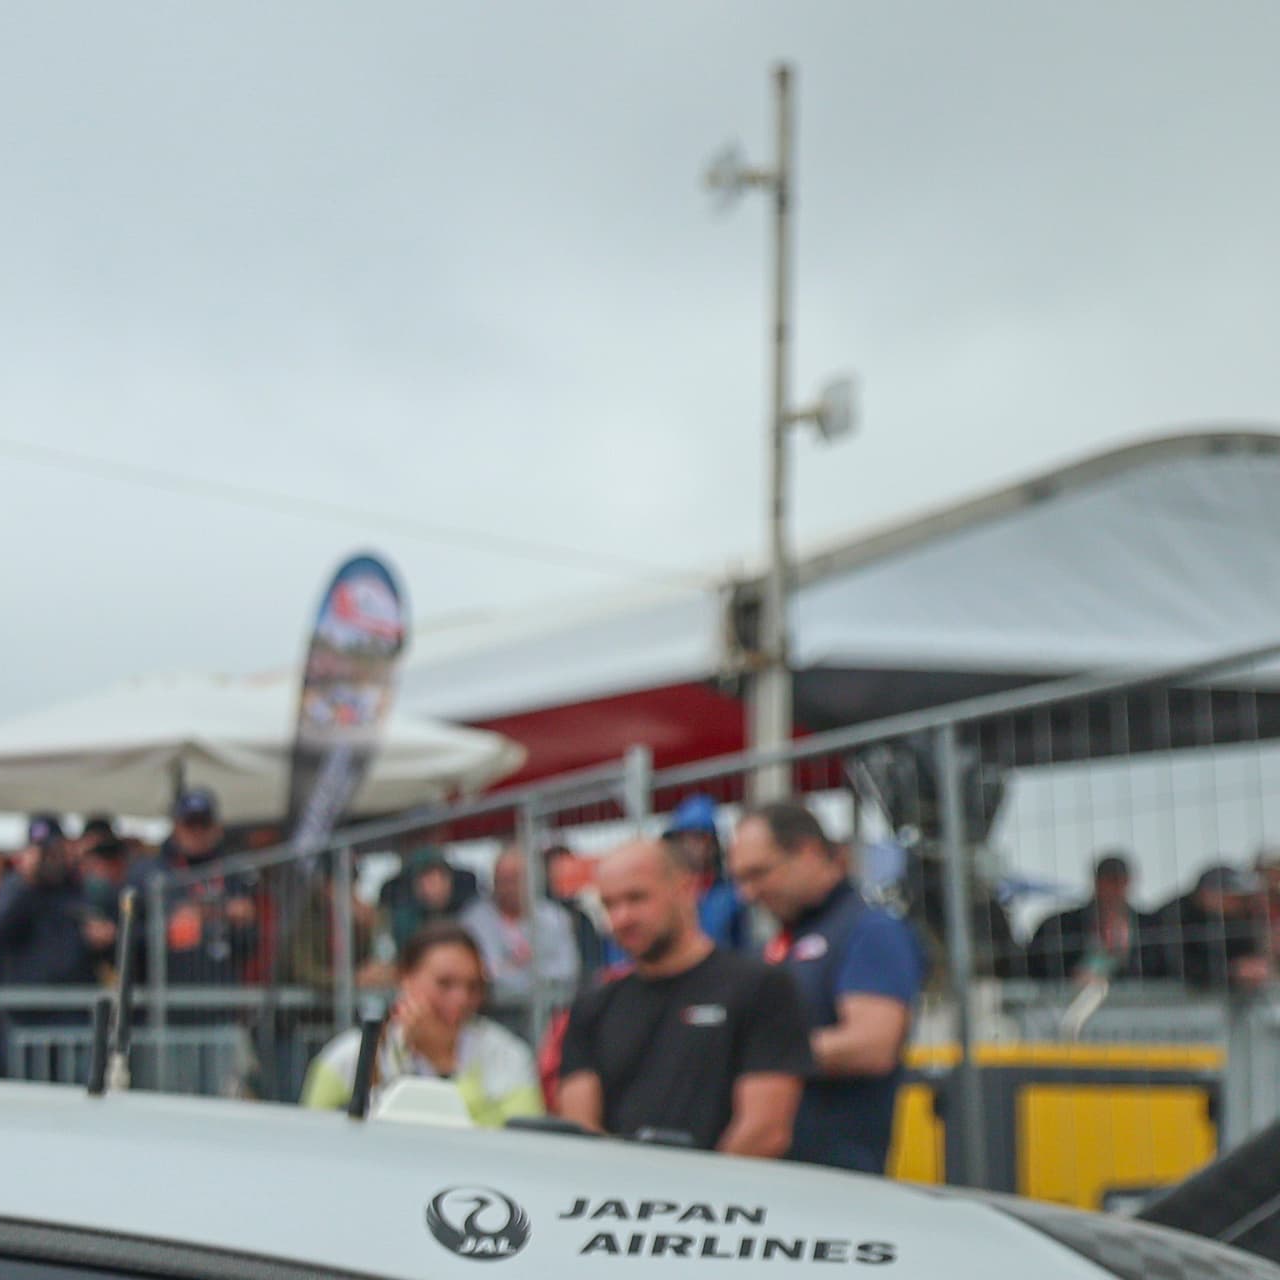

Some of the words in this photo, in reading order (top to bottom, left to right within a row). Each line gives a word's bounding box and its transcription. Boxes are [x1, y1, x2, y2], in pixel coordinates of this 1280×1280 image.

[558, 1197, 768, 1226] JAPAN
[457, 1235, 517, 1256] JAL
[579, 1231, 899, 1266] AIRLINES
